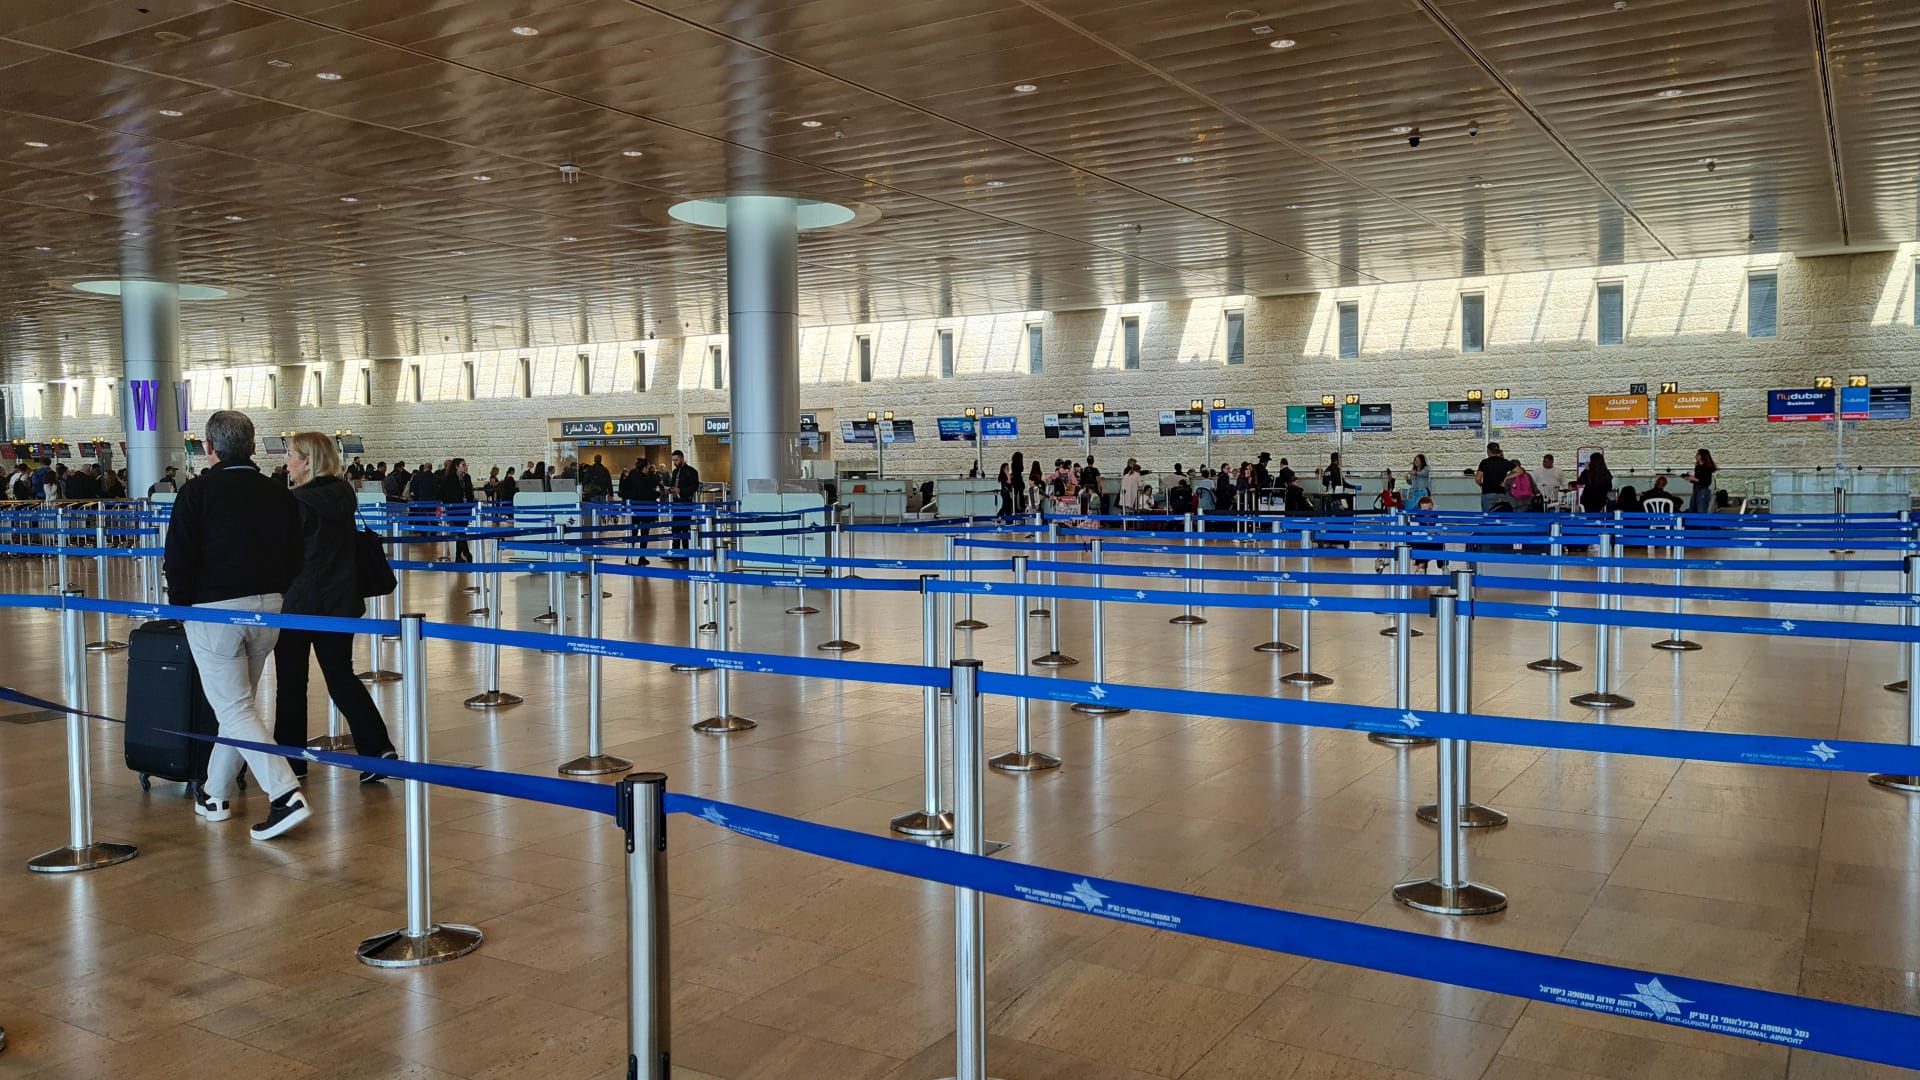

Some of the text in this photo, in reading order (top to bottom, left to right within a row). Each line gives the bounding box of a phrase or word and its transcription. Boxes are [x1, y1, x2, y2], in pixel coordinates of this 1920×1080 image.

[1816, 377, 1833, 388] 72
[1850, 376, 1867, 386] 73
[1631, 384, 1646, 393] 70
[1662, 383, 1676, 392] 71
[1468, 390, 1481, 399] 68
[1494, 389, 1509, 398] 69
[1213, 399, 1225, 408] 65
[1322, 395, 1335, 404] 66
[1346, 395, 1359, 403] 67
[130, 380, 159, 431] W
[1191, 400, 1203, 408] 64
[1217, 411, 1246, 423] arkia
[616, 422, 655, 432] המראות
[706, 420, 729, 431] Depar
[986, 419, 1011, 429] arkia
[1580, 1001, 1613, 1012] AIRPORTS
[1614, 1006, 1654, 1018] AUTHORITY
[1710, 1015, 1718, 1023] בן
[1711, 1023, 1768, 1038] INTERNATIONAL
[1769, 1034, 1804, 1045] AIRPORT
